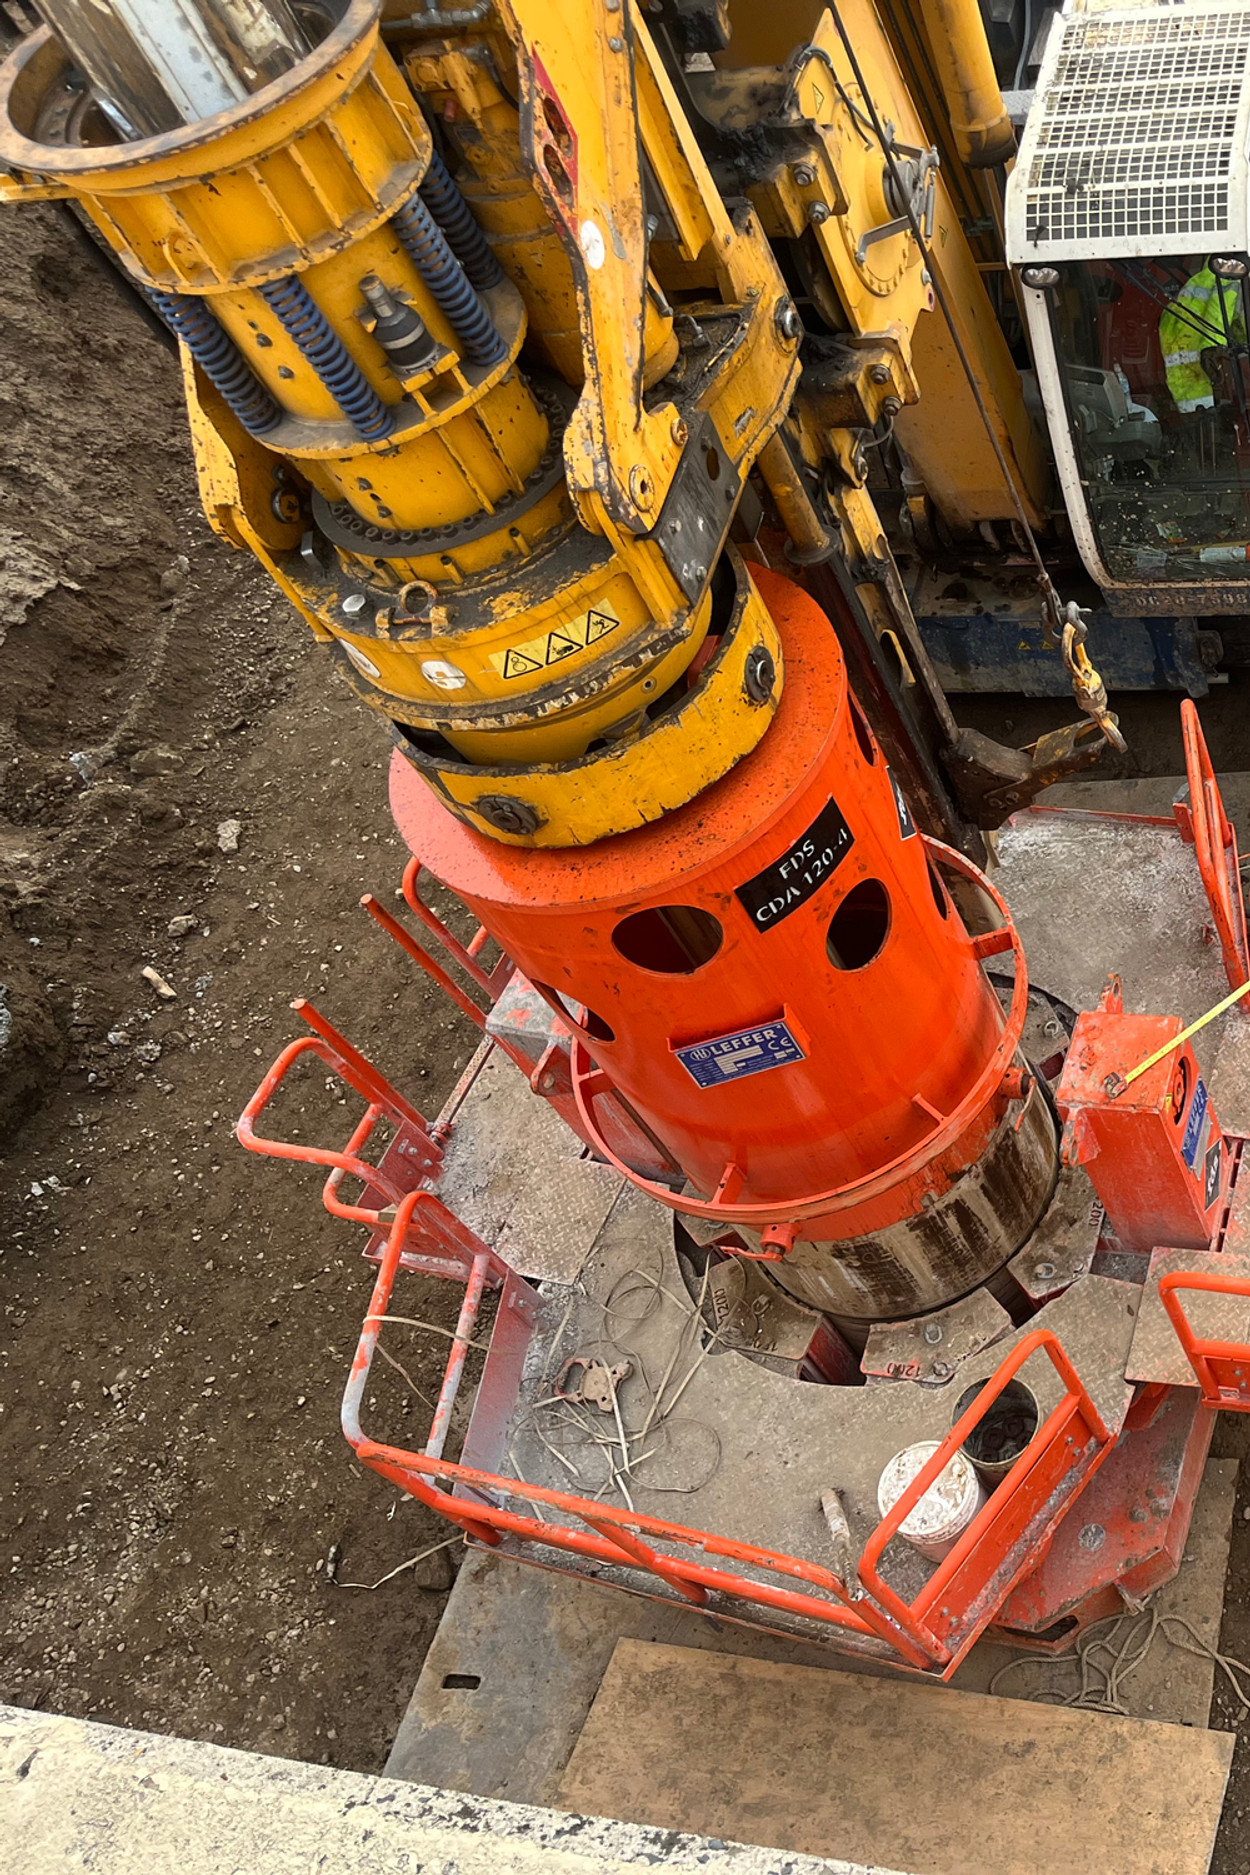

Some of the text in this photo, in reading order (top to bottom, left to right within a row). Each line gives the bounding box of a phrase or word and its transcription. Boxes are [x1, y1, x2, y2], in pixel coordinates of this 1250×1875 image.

[779, 839, 815, 879] FDS
[756, 886, 801, 921] CDA
[710, 1028, 778, 1055] LEFFER
[1089, 1197, 1104, 1227] 200
